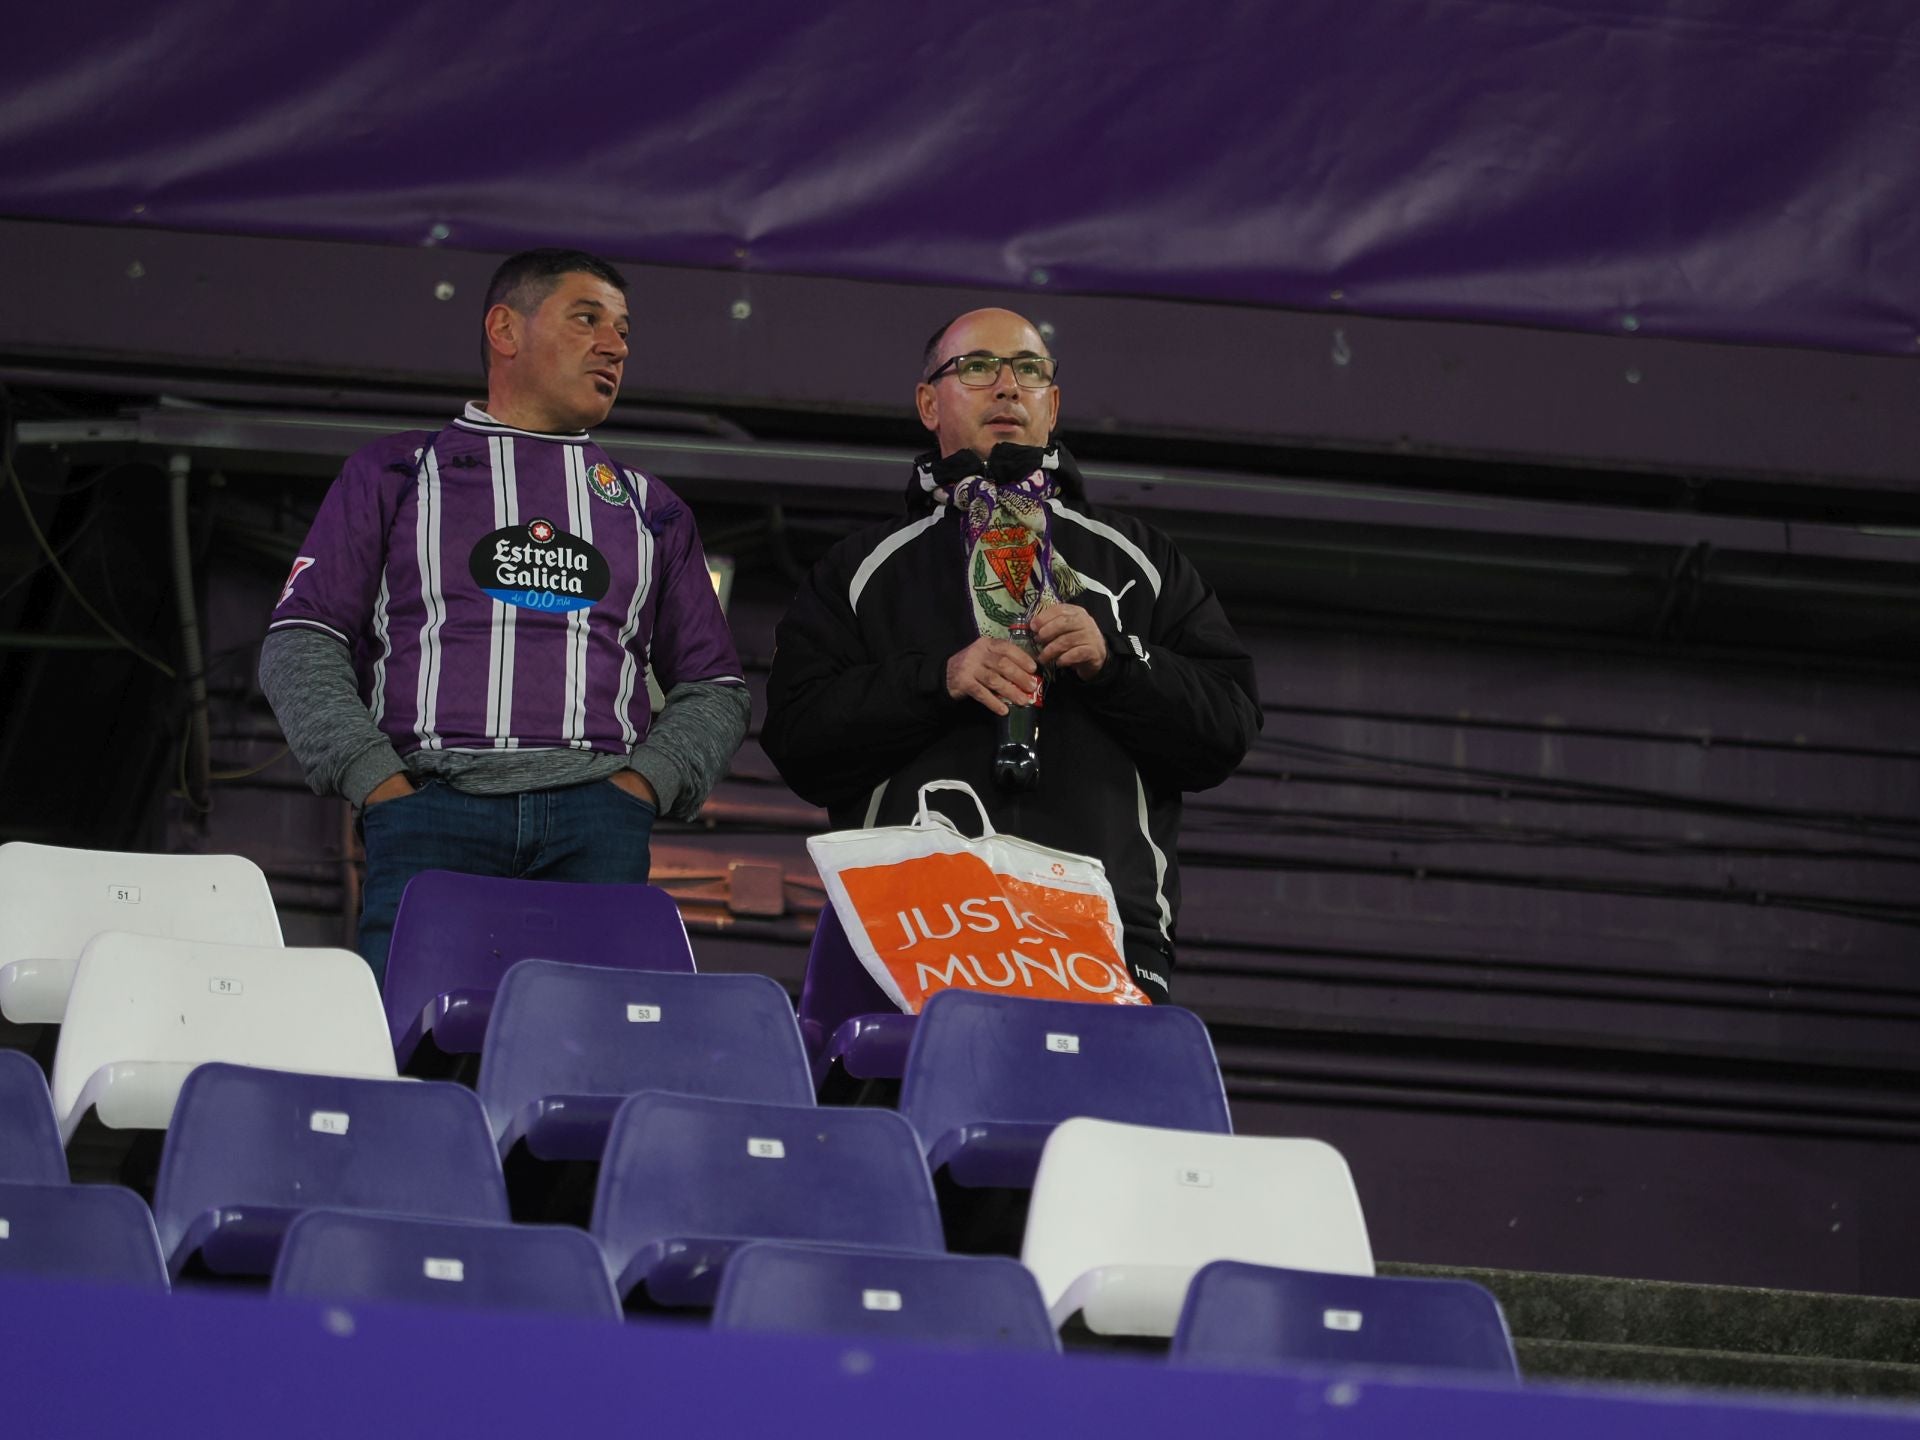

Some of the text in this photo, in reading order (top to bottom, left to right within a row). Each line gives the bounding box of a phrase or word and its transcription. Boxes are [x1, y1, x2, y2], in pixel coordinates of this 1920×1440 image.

[492, 539, 588, 571] Estrella
[496, 563, 583, 593] Galicia
[117, 890, 128, 901] 51
[219, 980, 231, 992] 51
[638, 1009, 650, 1020] 53
[1057, 1039, 1069, 1050] 55
